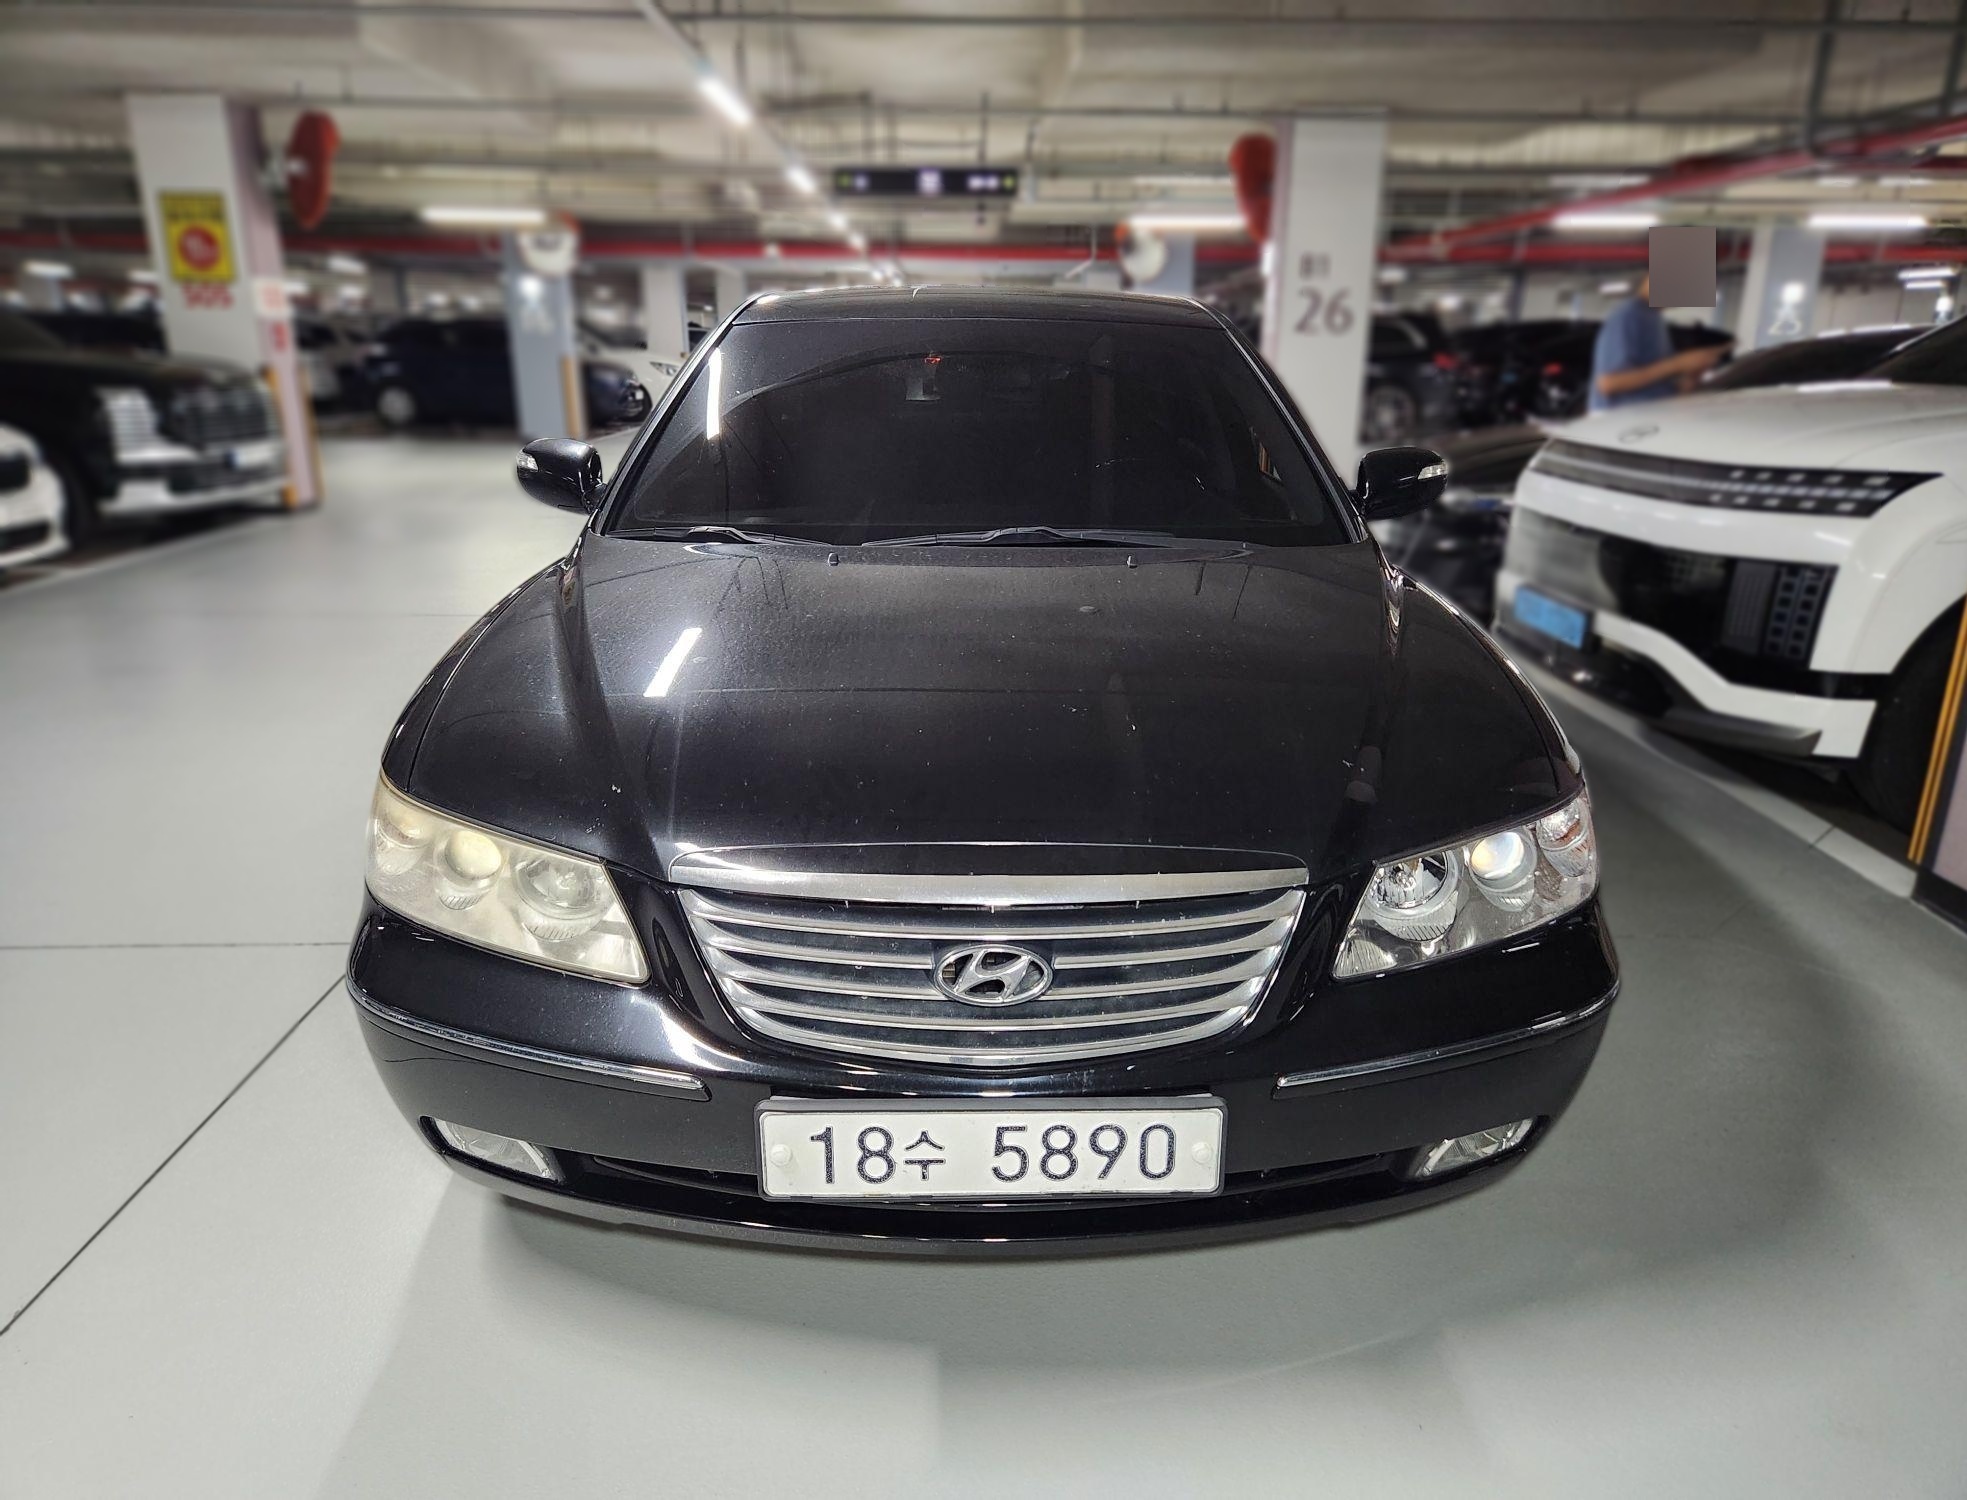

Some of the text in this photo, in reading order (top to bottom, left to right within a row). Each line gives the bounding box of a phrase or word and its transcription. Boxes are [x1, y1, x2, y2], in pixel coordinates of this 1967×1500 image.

[1294, 287, 1355, 336] 26
[810, 1123, 1177, 1185] 18수 5890
